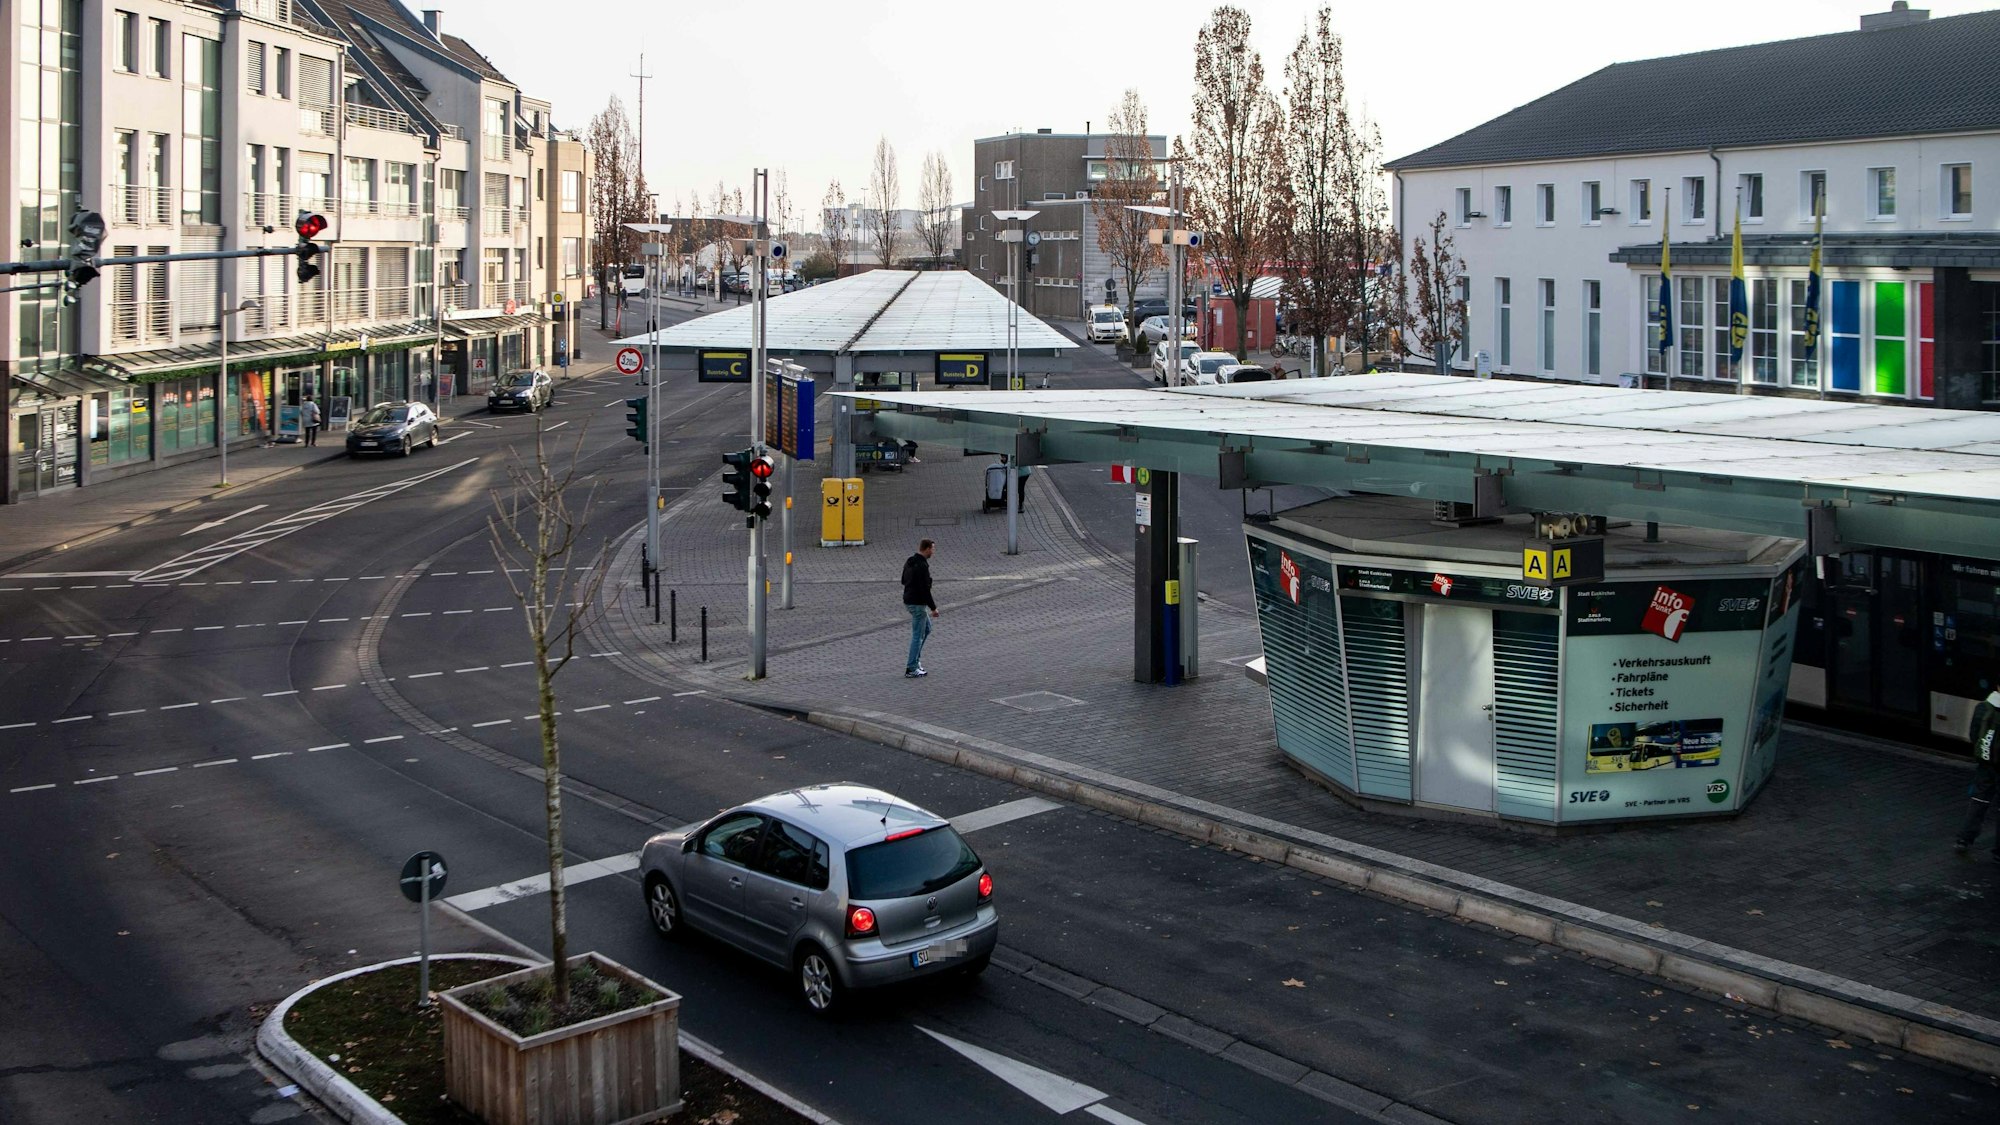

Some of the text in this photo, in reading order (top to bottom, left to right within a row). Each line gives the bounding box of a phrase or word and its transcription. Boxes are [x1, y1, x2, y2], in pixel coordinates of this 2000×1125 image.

[730, 361, 742, 376] C
[966, 364, 979, 378] D
[1528, 555, 1543, 574] A
[1556, 555, 1568, 574] A
[1506, 584, 1539, 600] SVE
[1653, 586, 1684, 610] info
[1650, 601, 1673, 615] Punkt
[1718, 598, 1747, 612] SVE
[1619, 655, 1711, 668] Verkehrsauskunft
[1617, 672, 1669, 683] Fahrpläne
[1616, 687, 1655, 697] Tickets
[1614, 700, 1669, 712] Sicherheit
[1980, 729, 1995, 761] adidas
[1706, 783, 1725, 793] VRS
[1569, 790, 1598, 804] SVE
